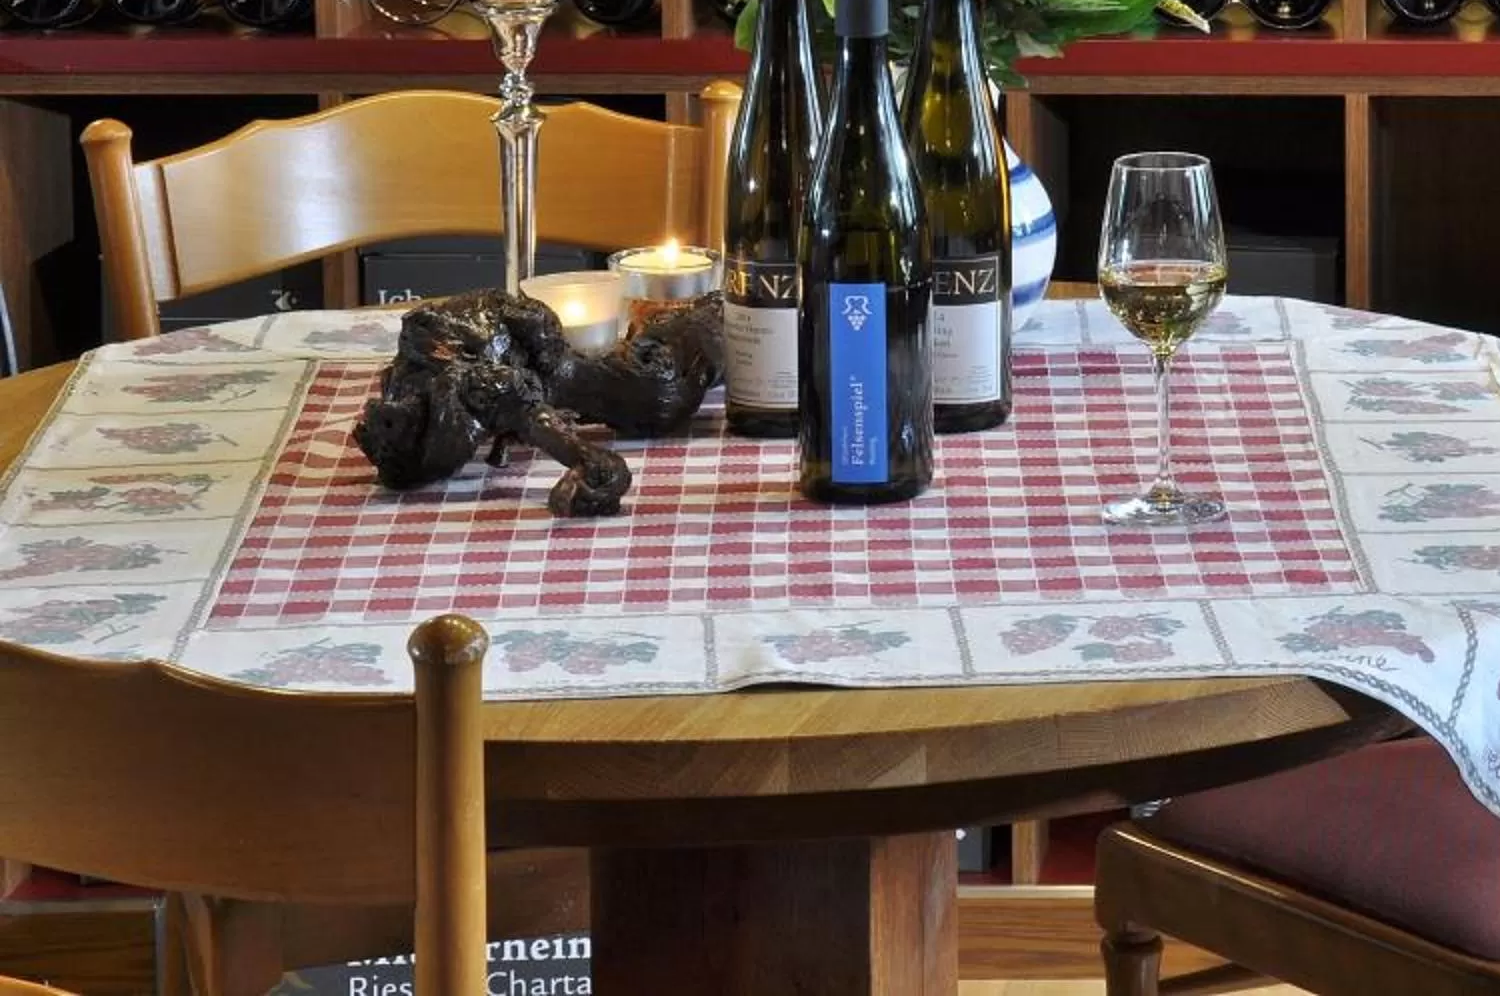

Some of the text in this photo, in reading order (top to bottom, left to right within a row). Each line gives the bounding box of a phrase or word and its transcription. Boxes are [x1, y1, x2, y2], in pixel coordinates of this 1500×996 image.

[727, 268, 793, 299] RENZ
[932, 268, 995, 295] ENZ
[349, 970, 592, 996] Ries Charta
